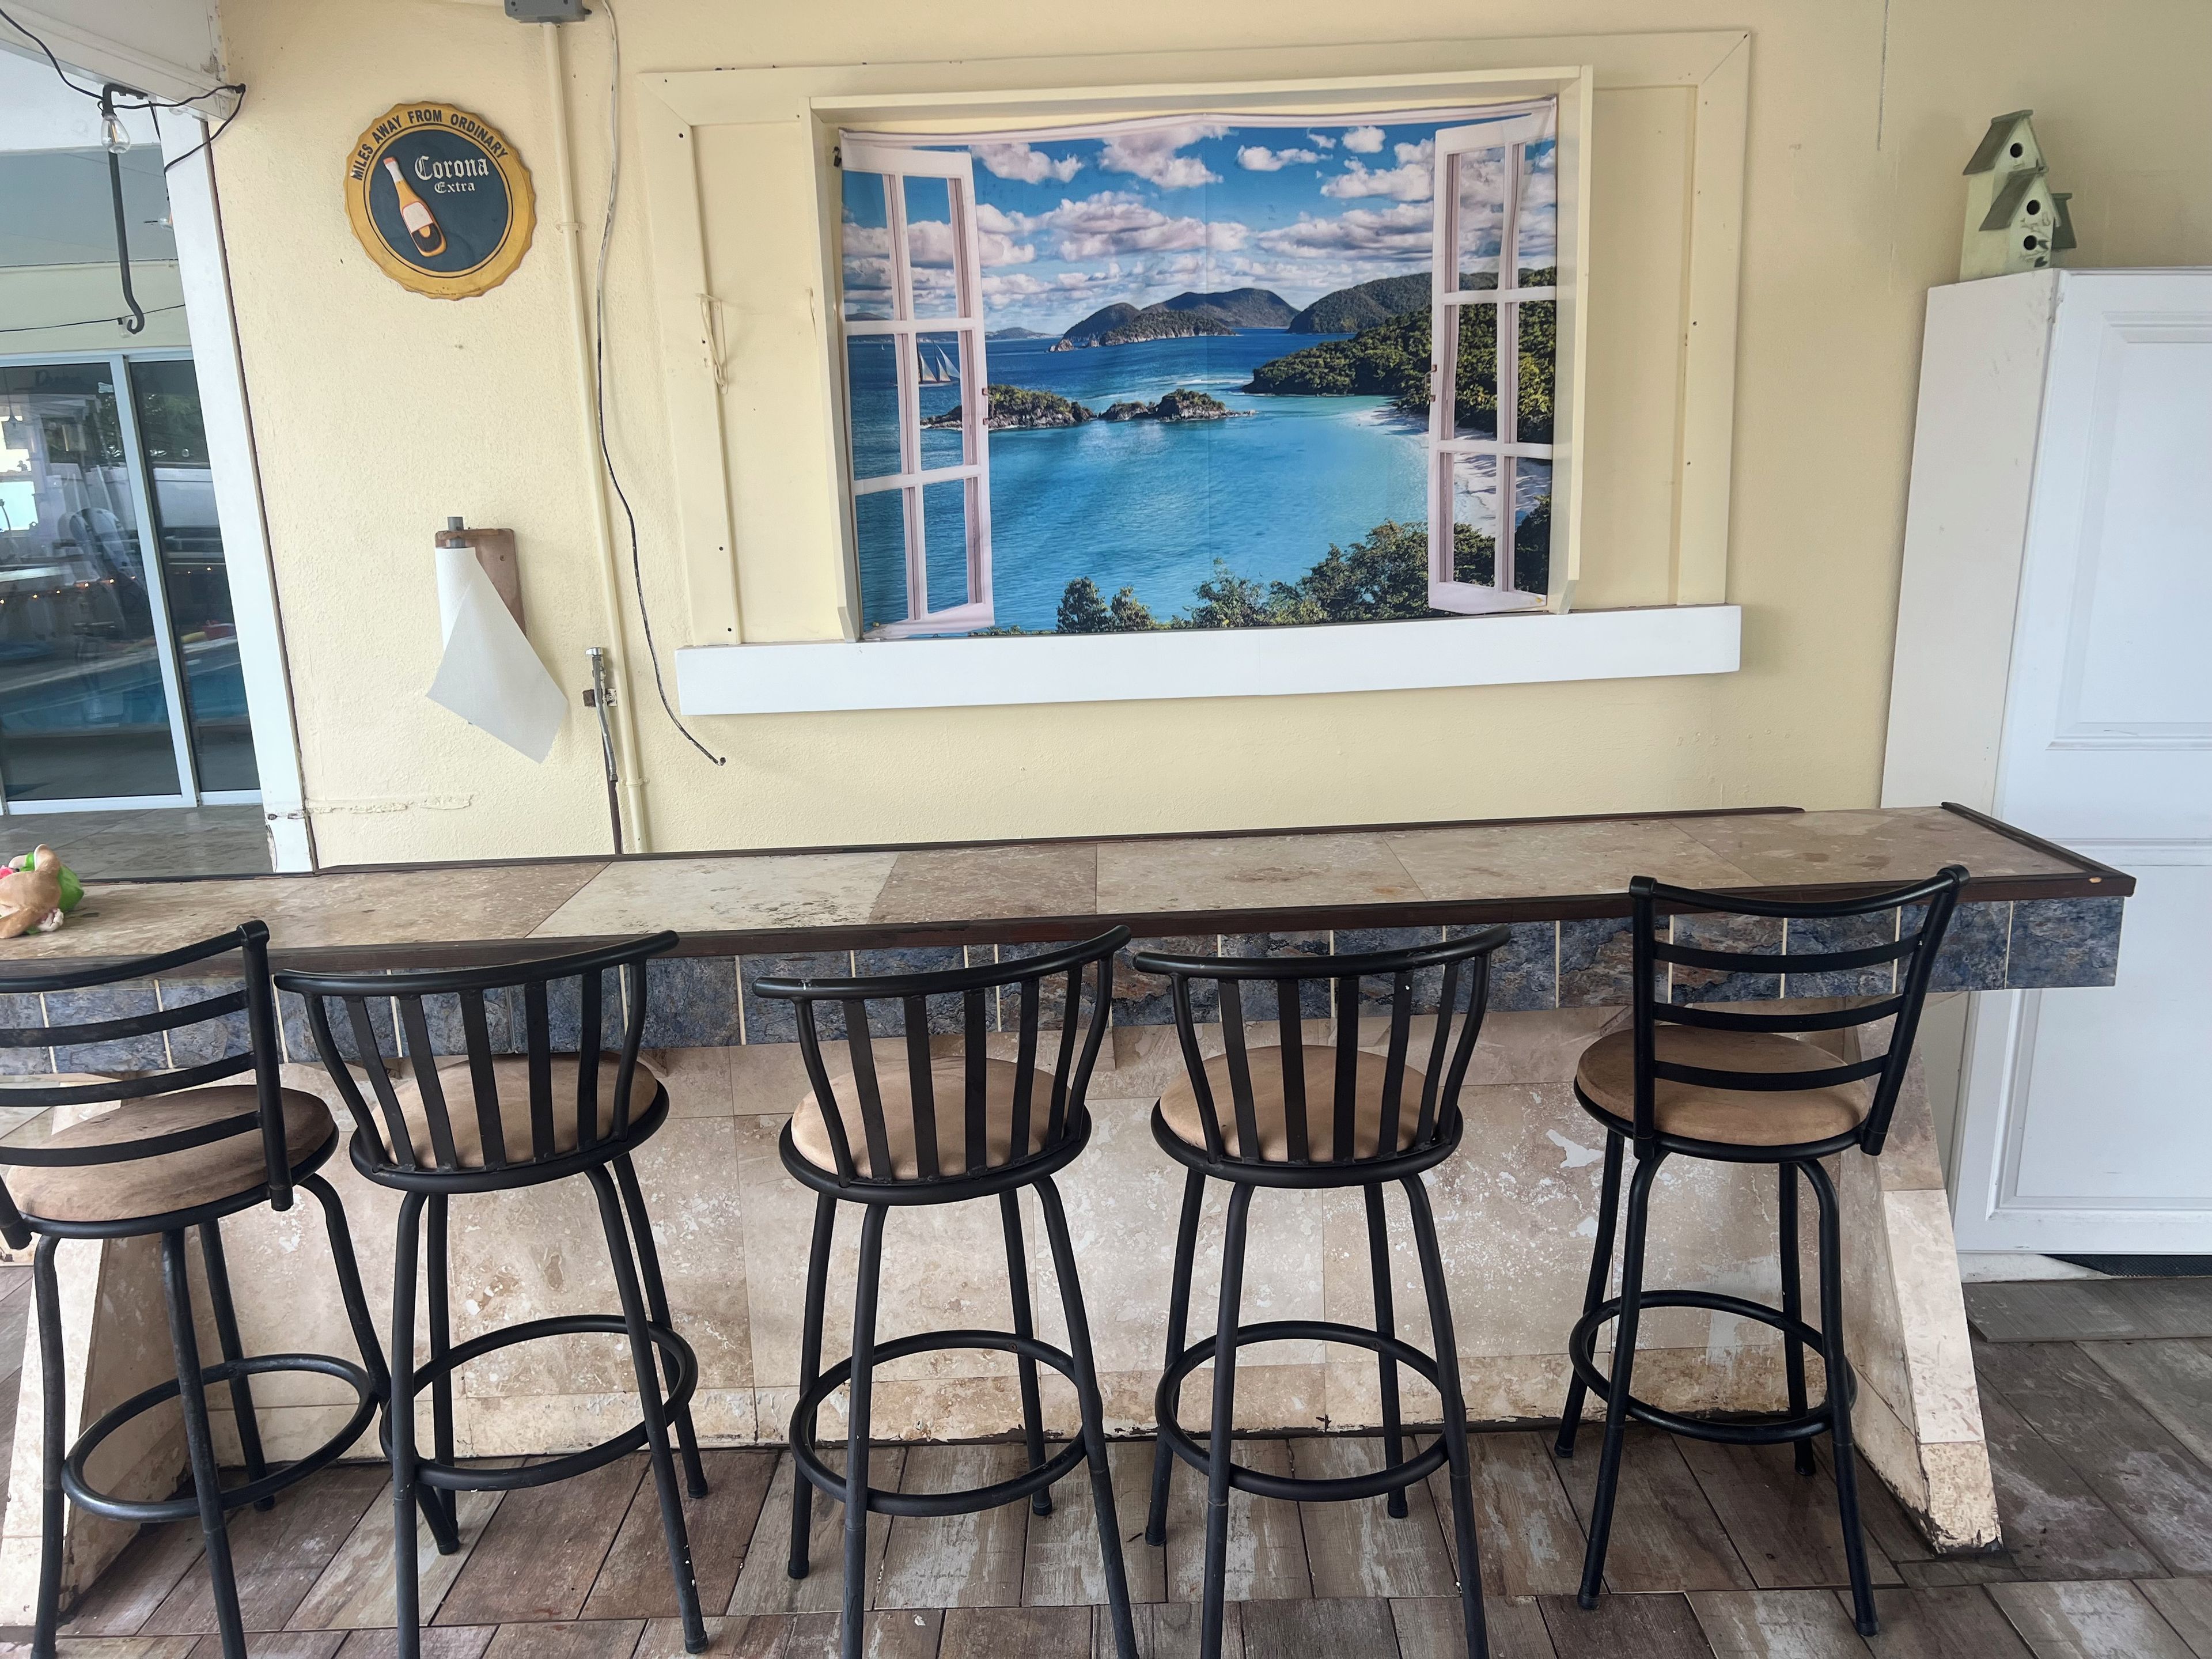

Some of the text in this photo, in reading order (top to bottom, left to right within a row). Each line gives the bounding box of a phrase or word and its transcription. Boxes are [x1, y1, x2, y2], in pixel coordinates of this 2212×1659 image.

[350, 109, 508, 180] MILES AWAY FROM ORDINARY
[415, 156, 490, 181] Corona
[434, 181, 475, 194] Extra
